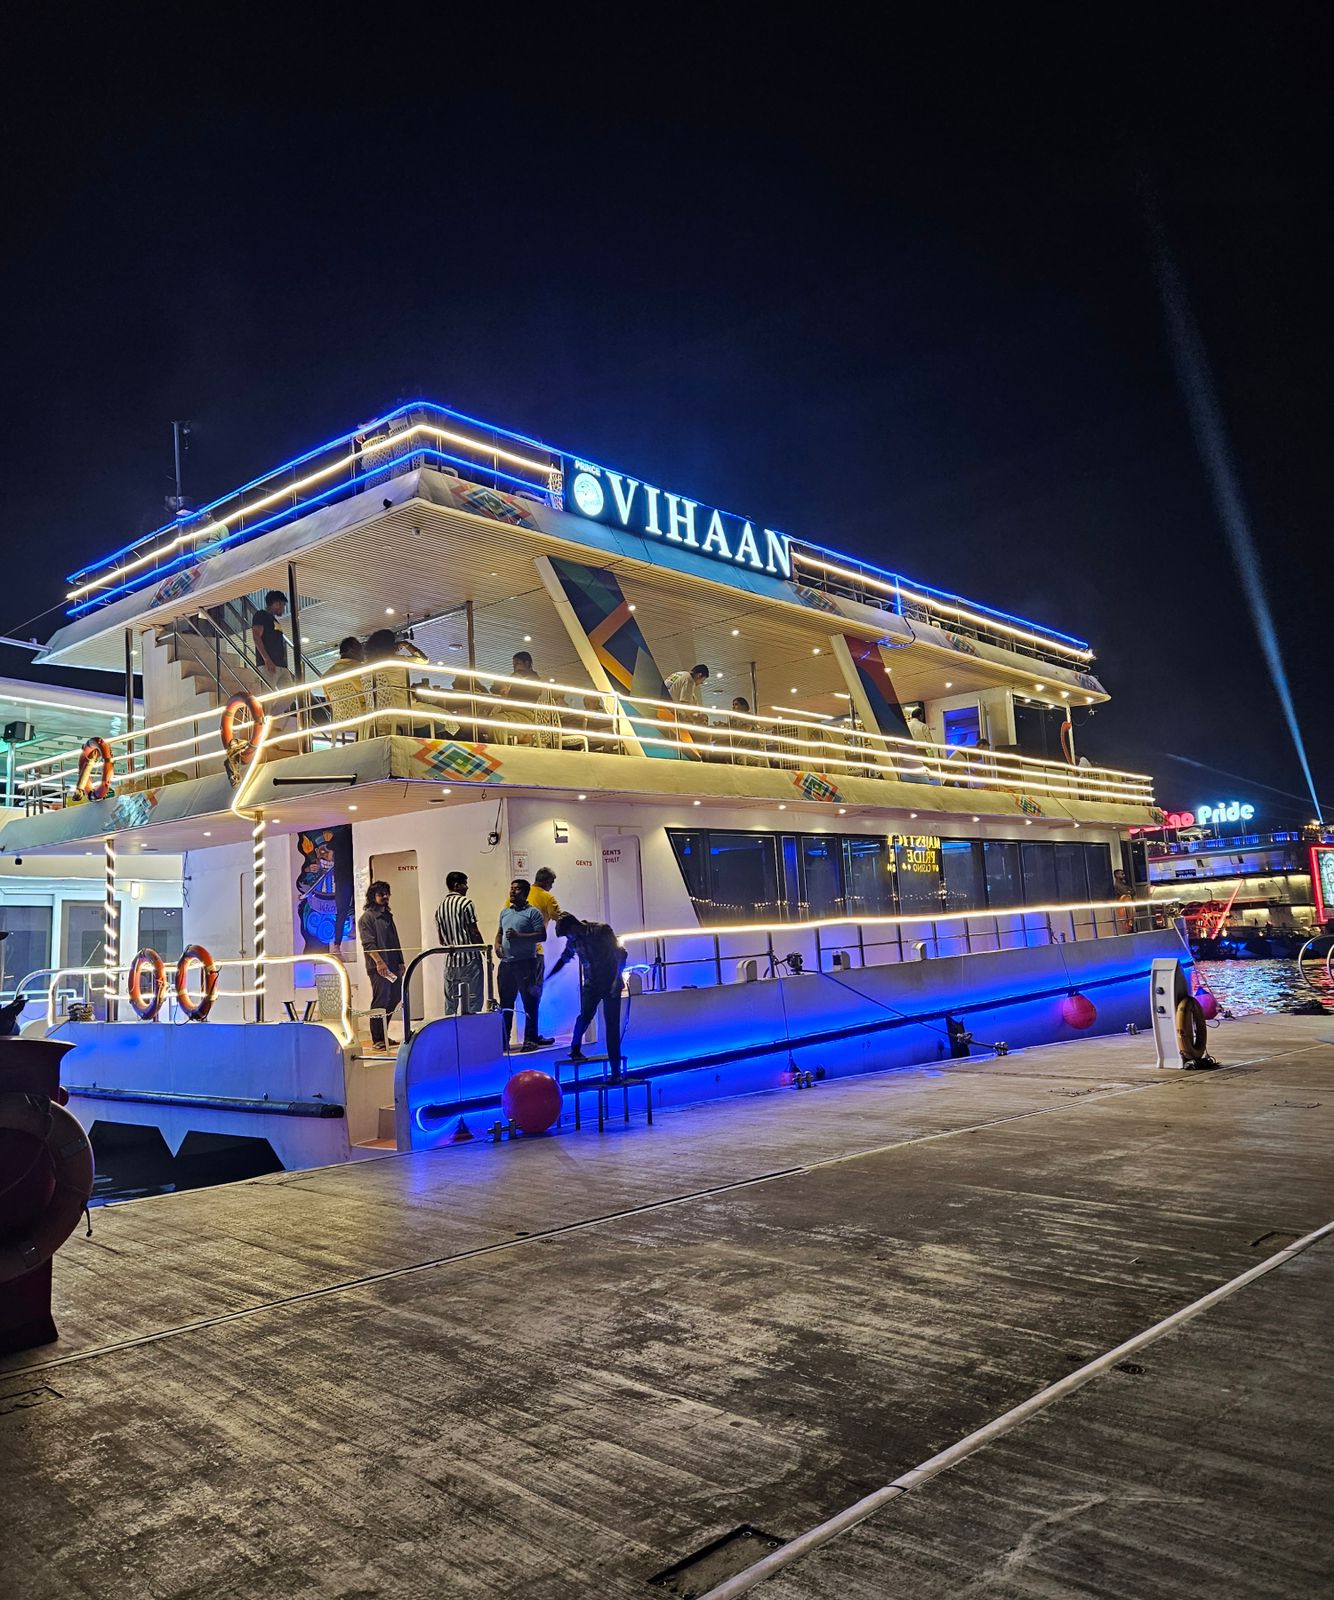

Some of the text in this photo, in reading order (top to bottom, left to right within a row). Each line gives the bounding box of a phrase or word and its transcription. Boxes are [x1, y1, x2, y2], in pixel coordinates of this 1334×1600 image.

[606, 471, 791, 578] VIHAAN
[1197, 802, 1255, 825] Pride
[575, 859, 593, 867] GENTS
